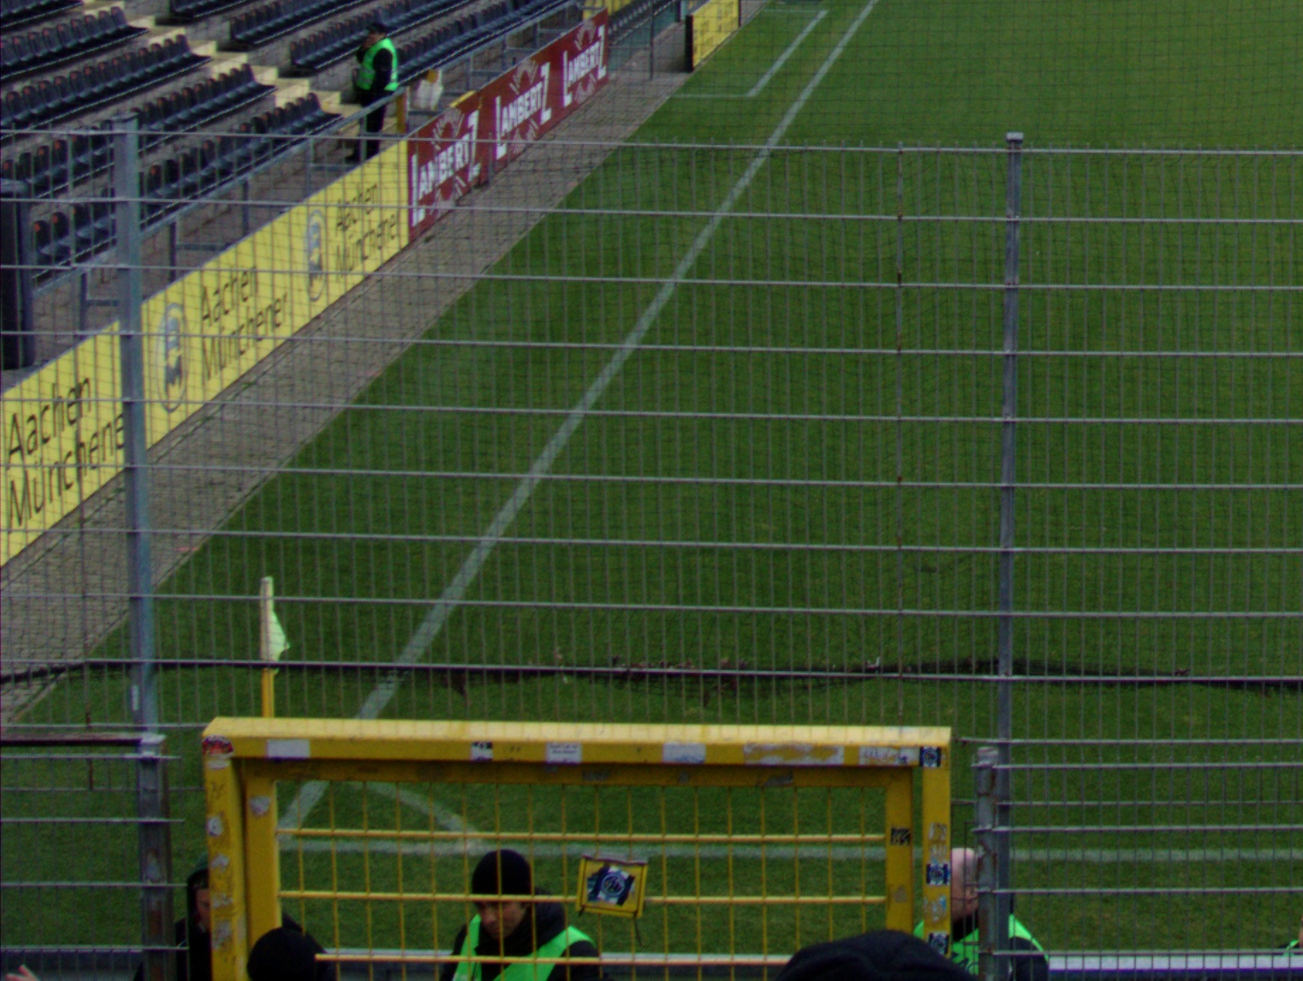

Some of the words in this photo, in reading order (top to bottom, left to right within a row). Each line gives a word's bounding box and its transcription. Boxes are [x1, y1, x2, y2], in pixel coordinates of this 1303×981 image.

[496, 61, 551, 161] LAMBERTZ
[562, 24, 607, 108] LAMBERTZ
[336, 182, 378, 238] Aachen
[411, 109, 481, 227] LAMBERTZ
[201, 265, 259, 327] Aachen
[202, 291, 289, 381] Münchener
[8, 377, 92, 470] Aachen
[8, 413, 124, 535] Münchene
